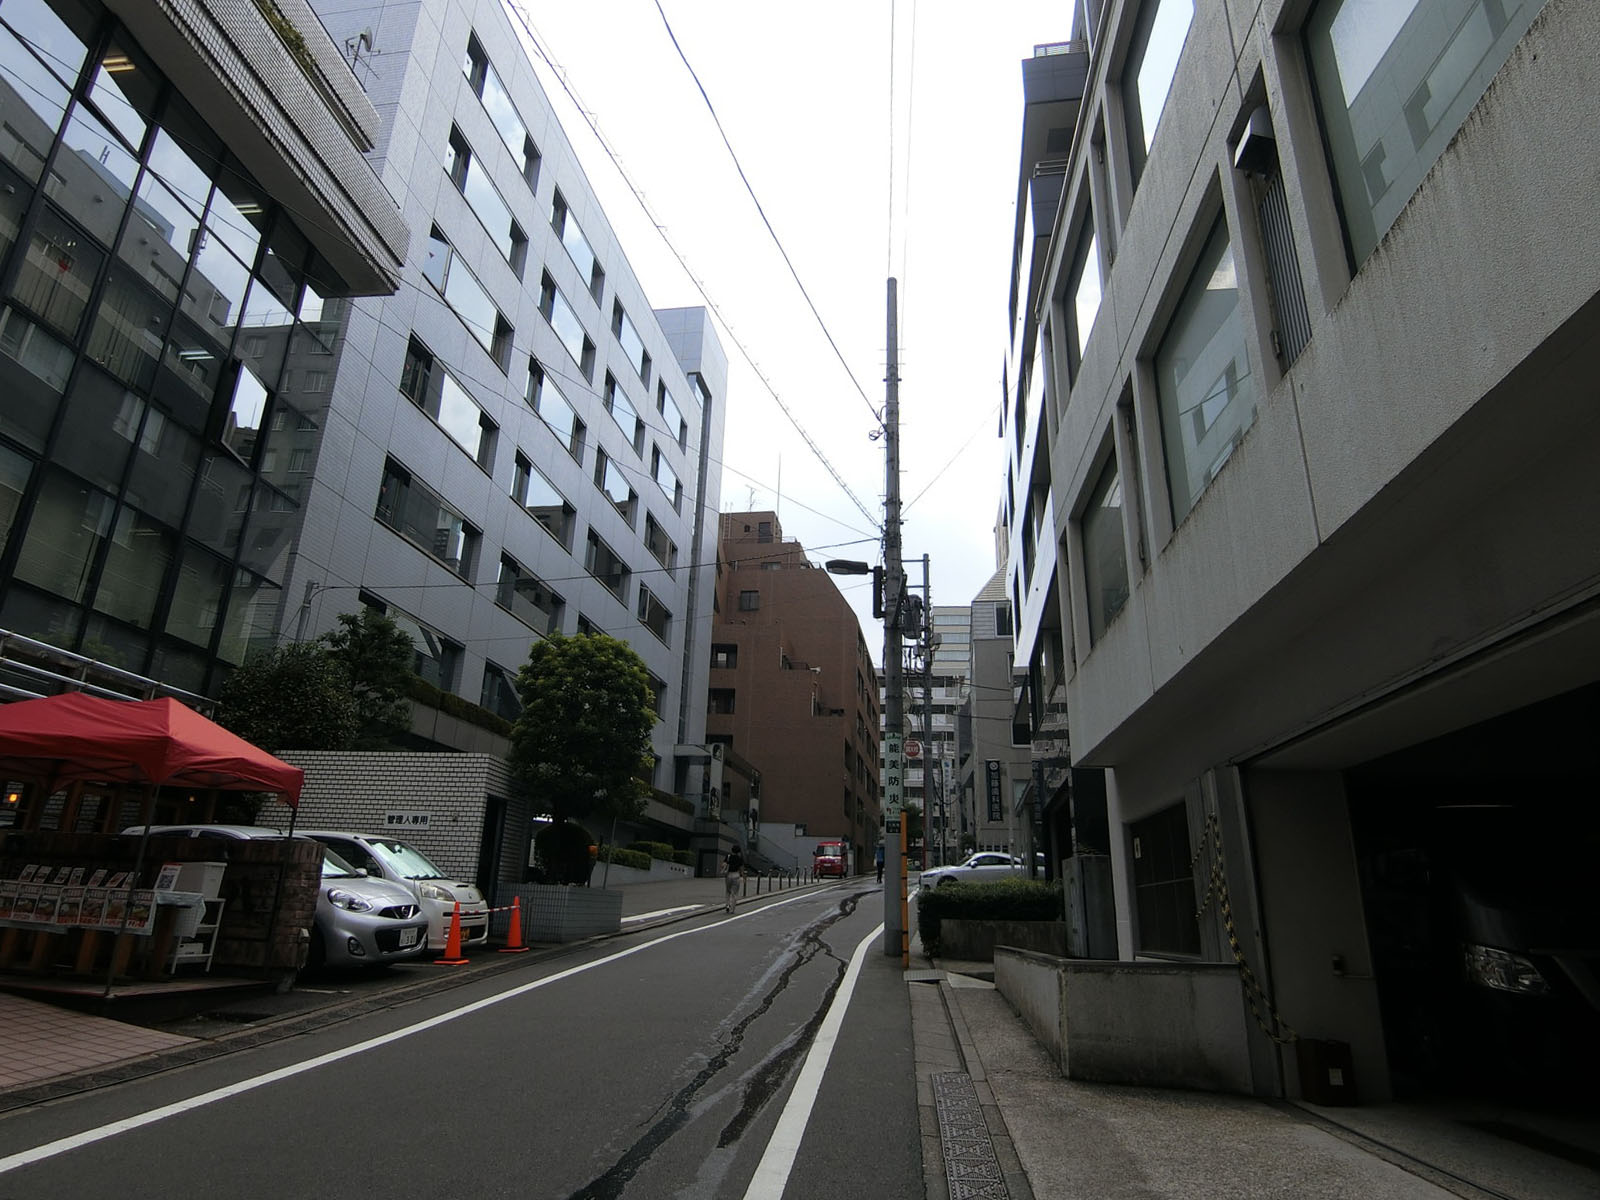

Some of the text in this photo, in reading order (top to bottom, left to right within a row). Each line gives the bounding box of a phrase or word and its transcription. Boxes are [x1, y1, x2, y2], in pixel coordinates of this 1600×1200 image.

[387, 814, 429, 825] 管理人専用
